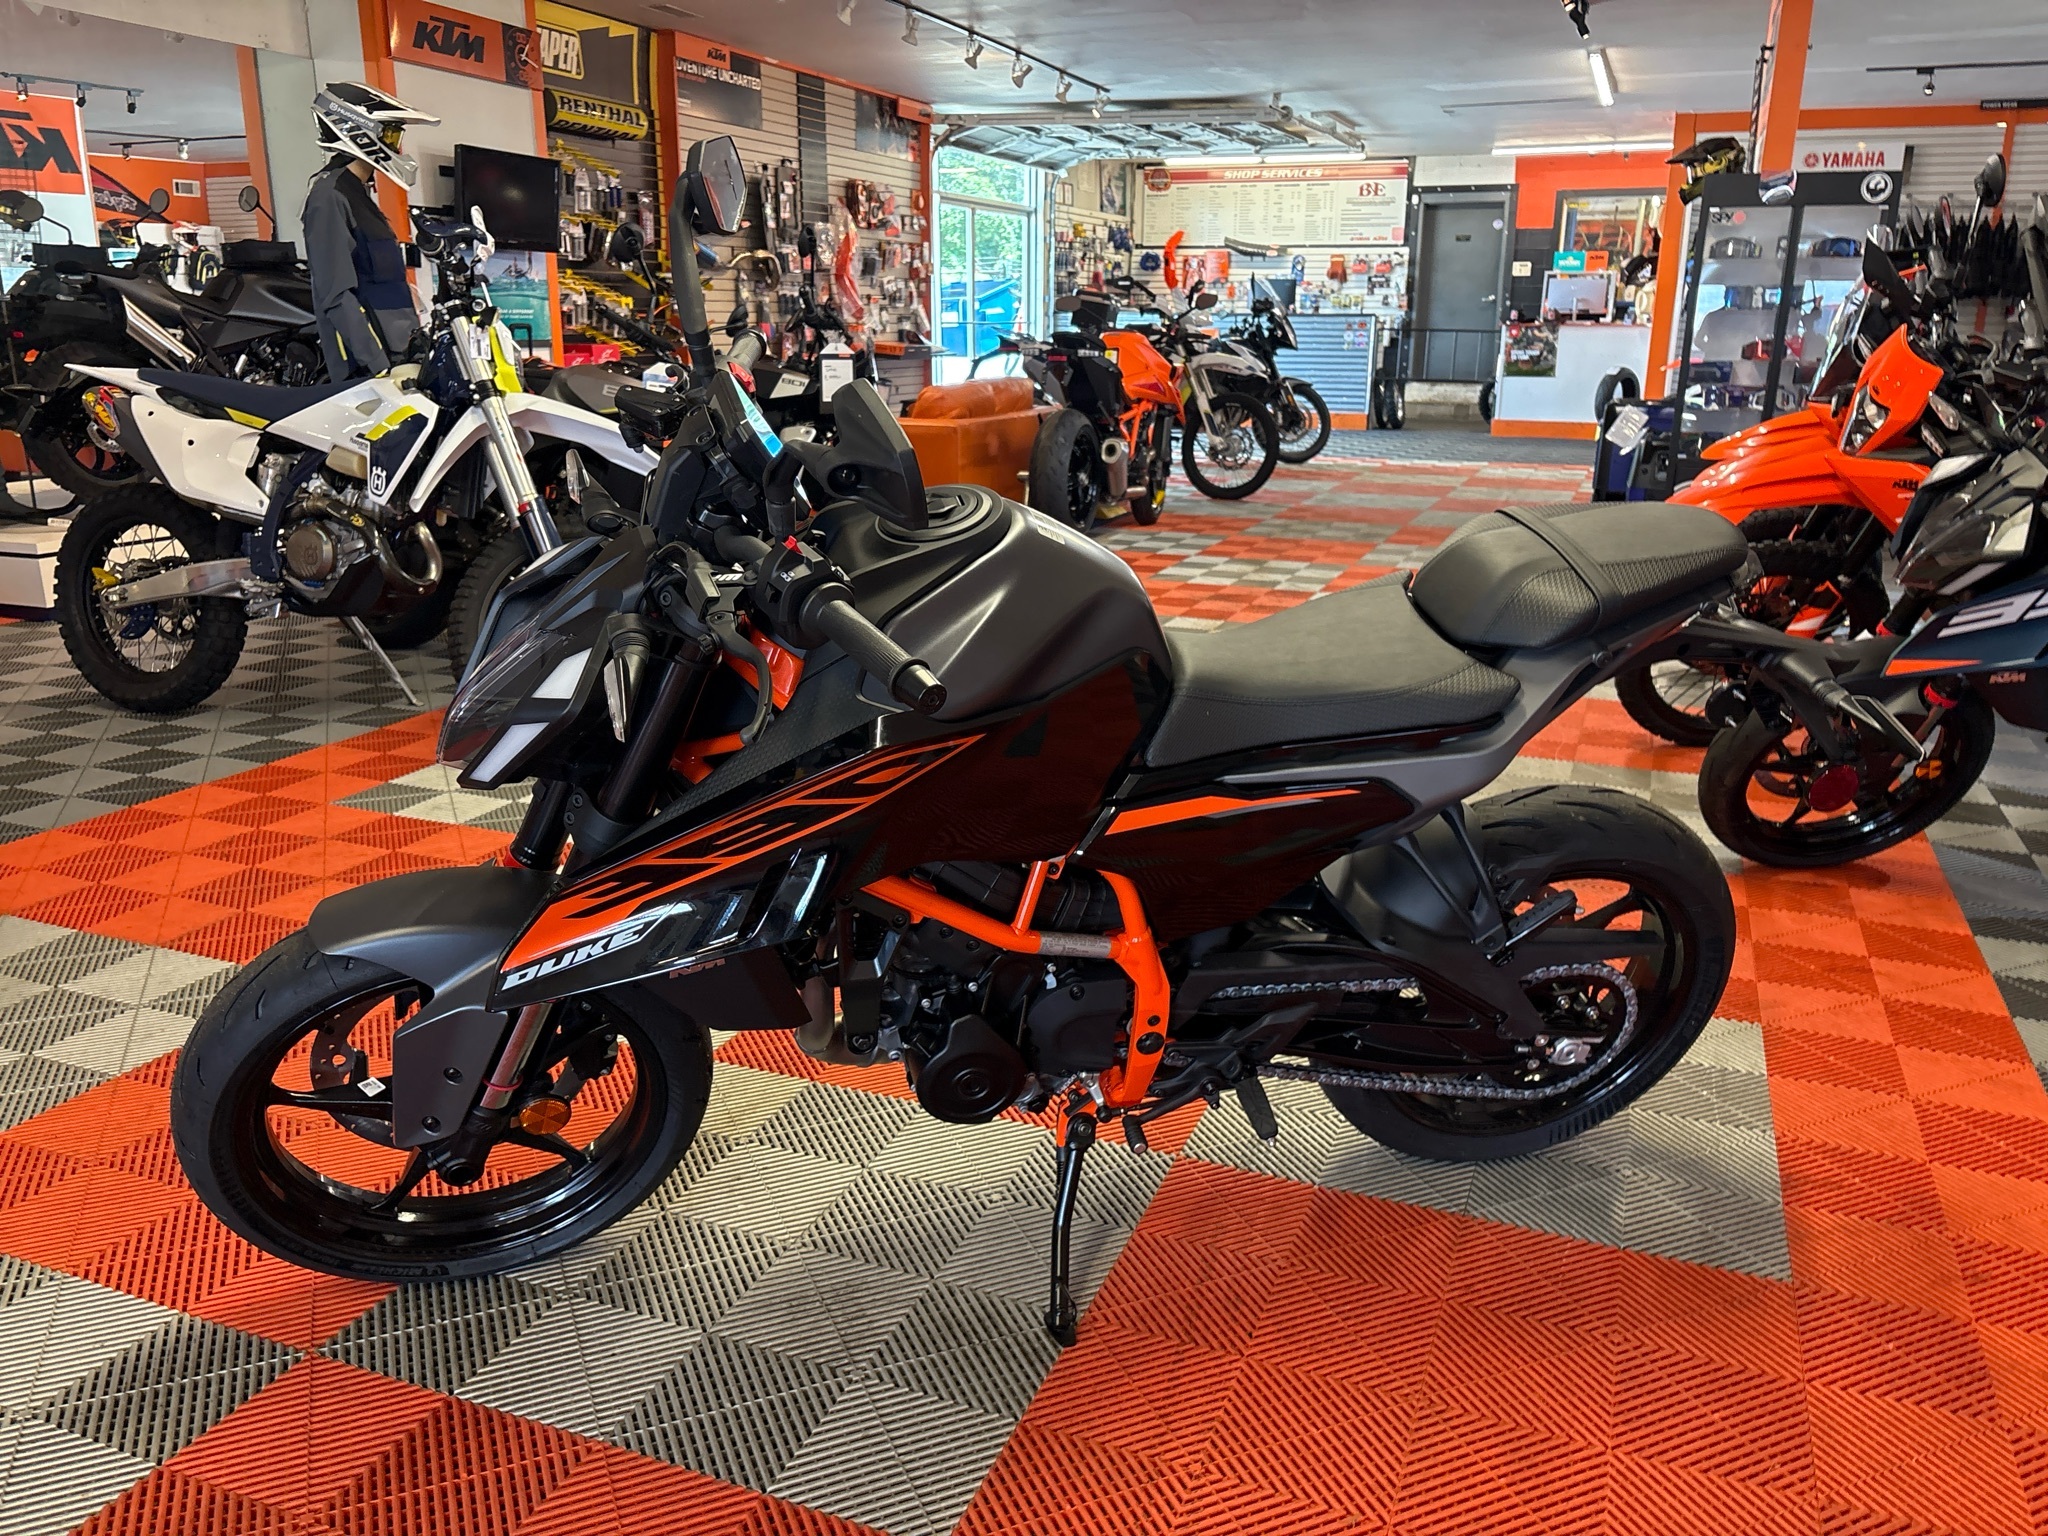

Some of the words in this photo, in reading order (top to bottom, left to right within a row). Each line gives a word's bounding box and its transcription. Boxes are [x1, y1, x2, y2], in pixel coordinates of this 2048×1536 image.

[412, 15, 485, 63] KTM
[537, 26, 579, 75] APER
[707, 47, 727, 62] KTM
[718, 69, 761, 90] UNCHARTED
[558, 95, 645, 127] RENTHAL
[1822, 151, 1885, 168] YAMAHA
[1224, 170, 1260, 180] SHOP
[1260, 168, 1323, 179] SERVICES
[501, 923, 645, 991] DUKE
